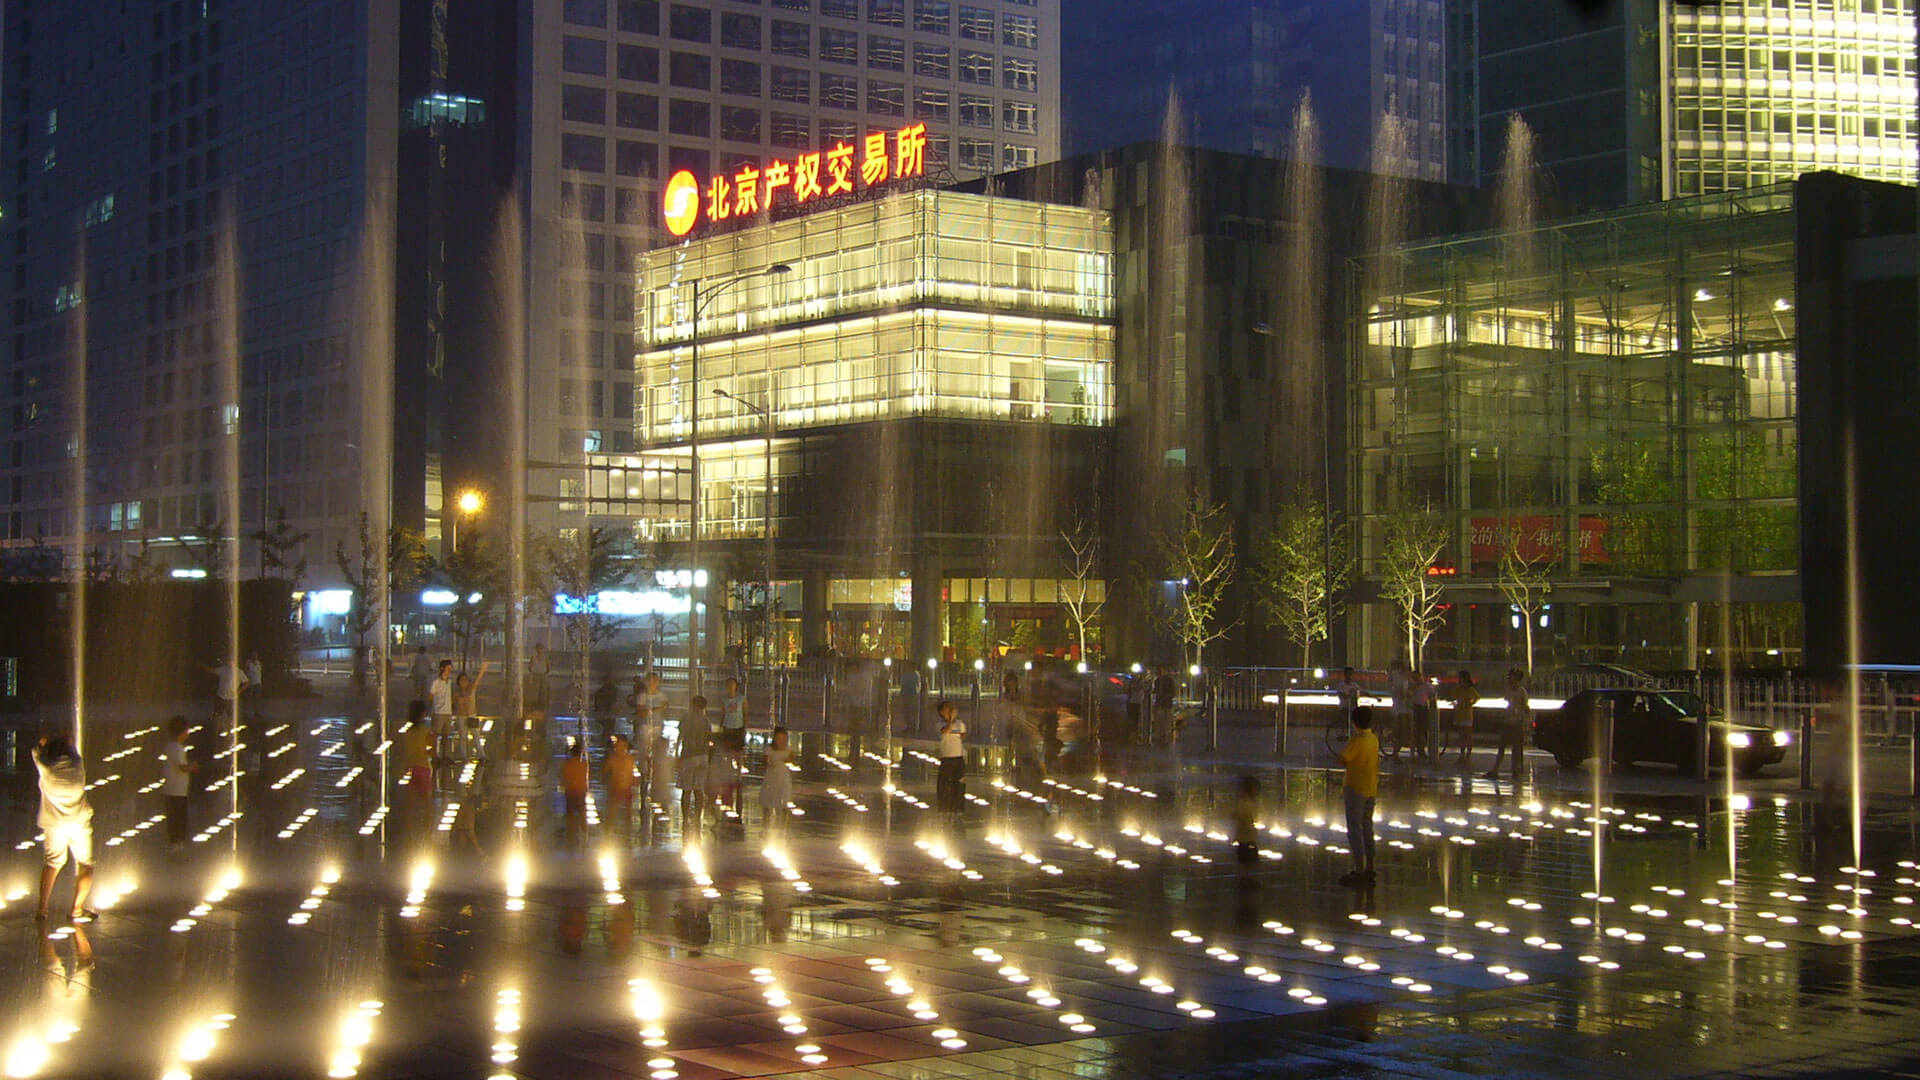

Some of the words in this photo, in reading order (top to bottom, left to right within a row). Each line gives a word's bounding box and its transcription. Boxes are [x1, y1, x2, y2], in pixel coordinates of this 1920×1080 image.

[706, 123, 927, 221] 北京产权交易所
